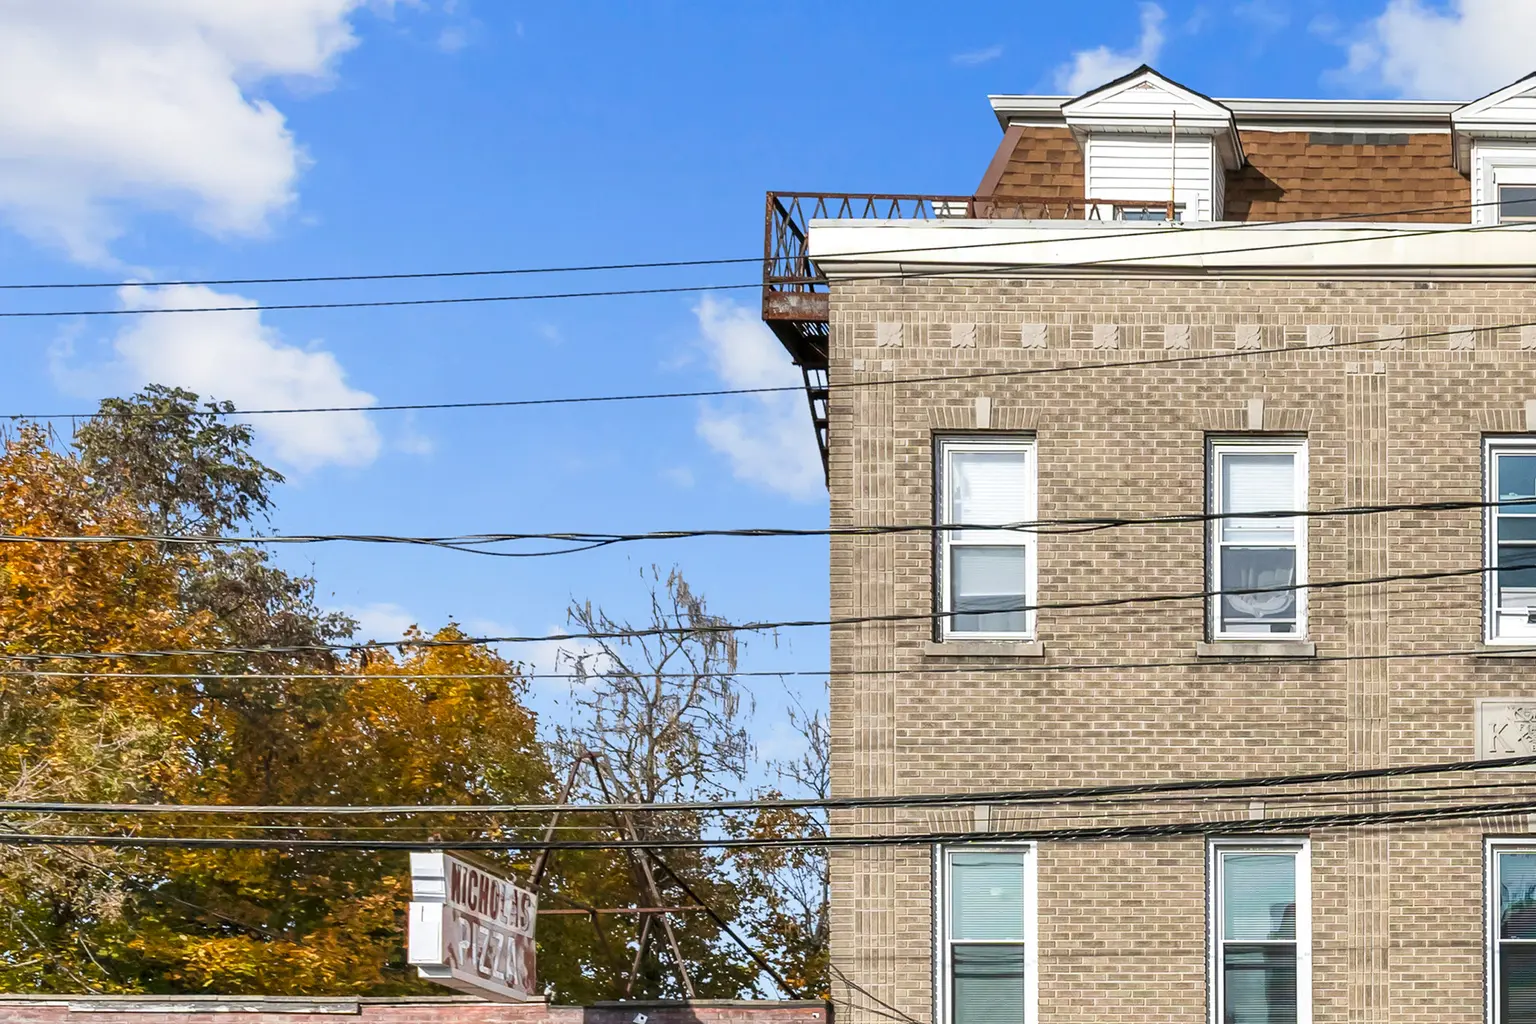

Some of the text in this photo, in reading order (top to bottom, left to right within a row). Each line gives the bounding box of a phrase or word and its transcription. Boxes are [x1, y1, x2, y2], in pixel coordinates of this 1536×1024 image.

[1488, 723, 1515, 753] K
[452, 862, 531, 932] NICHOLAS
[457, 915, 520, 986] PIZZA
